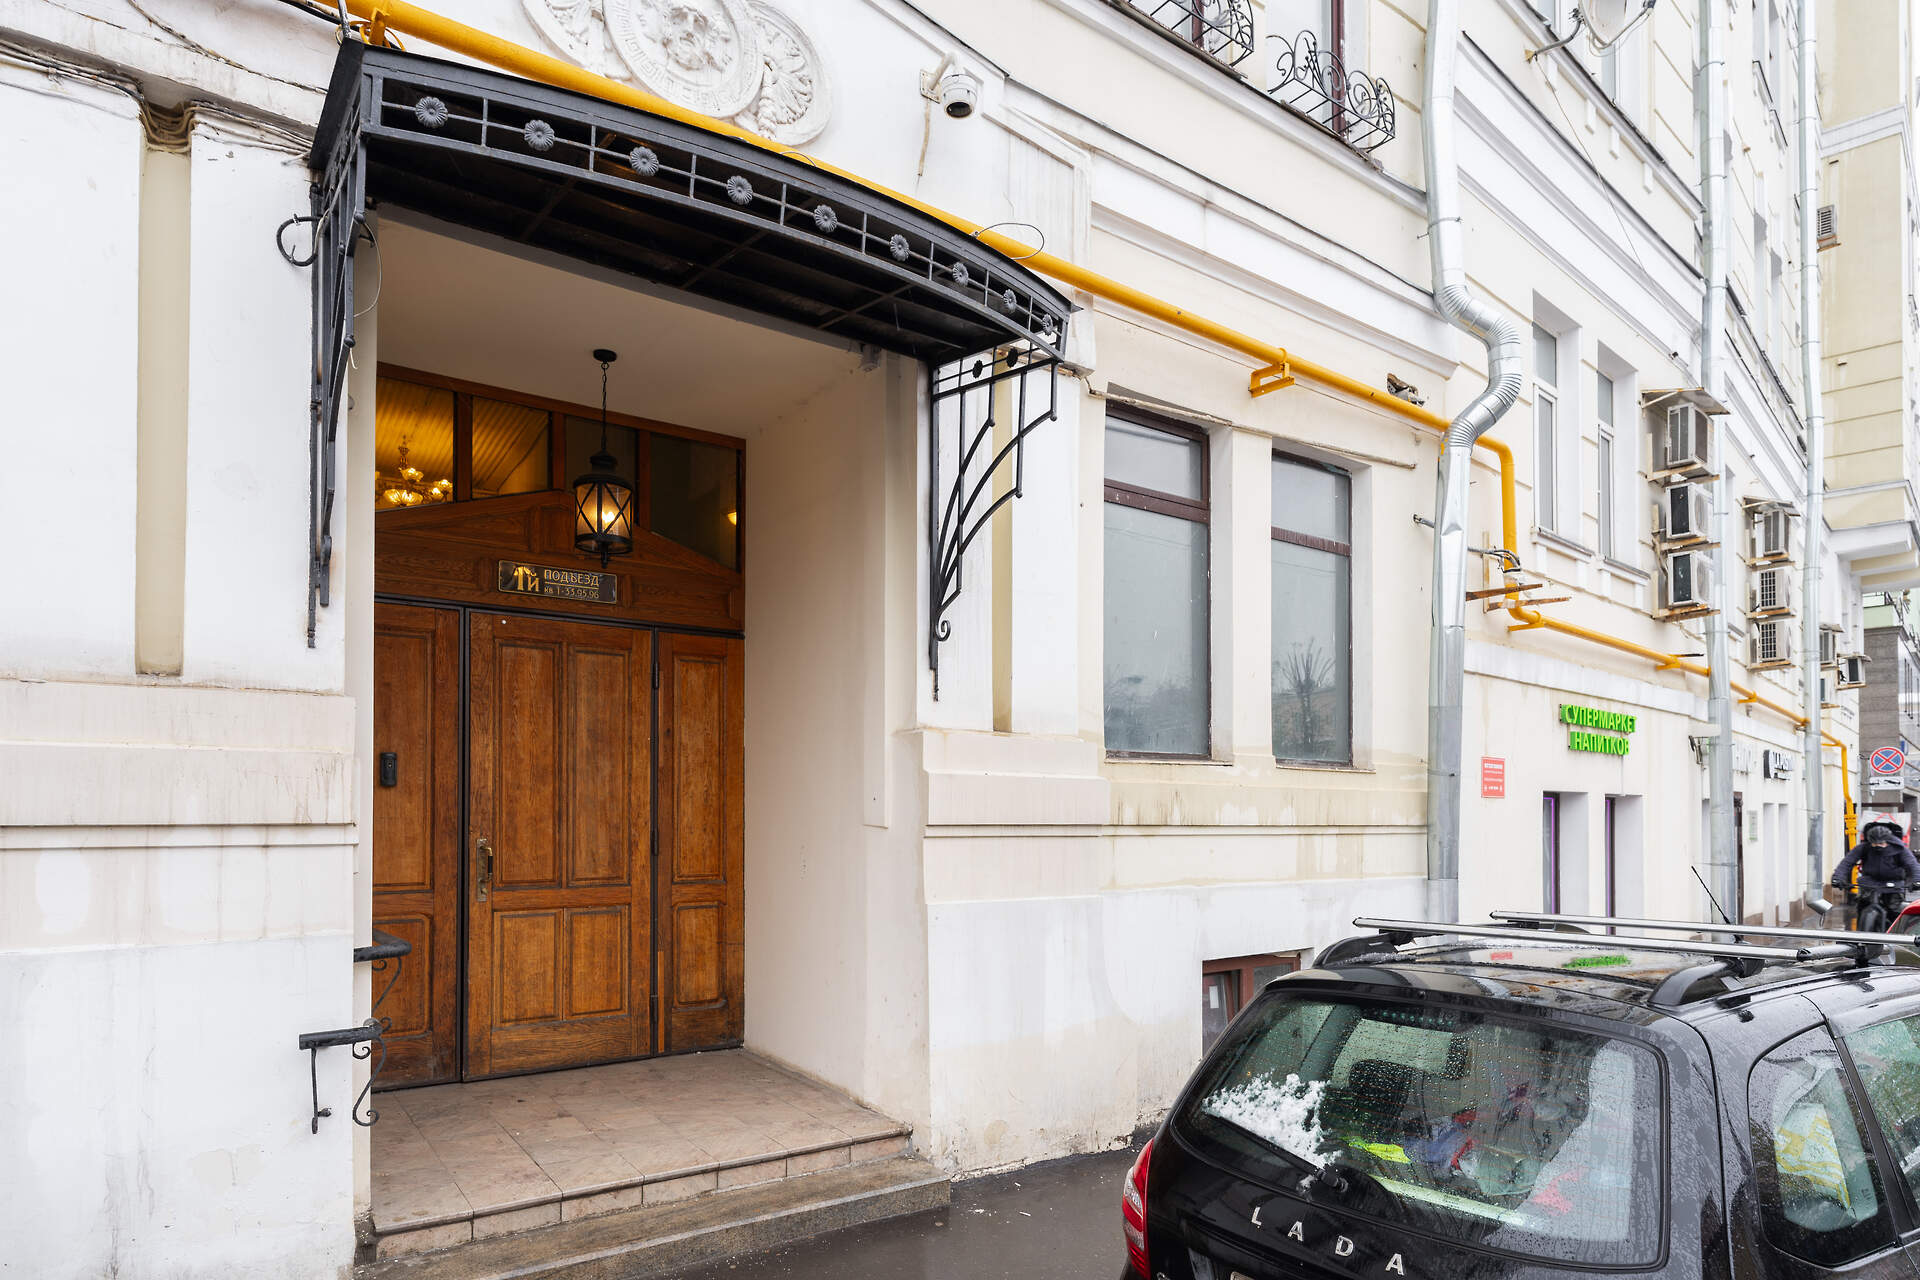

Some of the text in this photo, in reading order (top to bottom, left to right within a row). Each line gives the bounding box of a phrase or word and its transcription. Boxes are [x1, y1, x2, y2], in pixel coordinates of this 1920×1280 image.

[544, 569, 599, 586] ПОДЪЕЗД
[1563, 704, 1637, 732] СУПЕРМАРКЕТ
[1573, 731, 1630, 755] НАПИТКОВ
[1251, 1206, 1404, 1276] LADA
